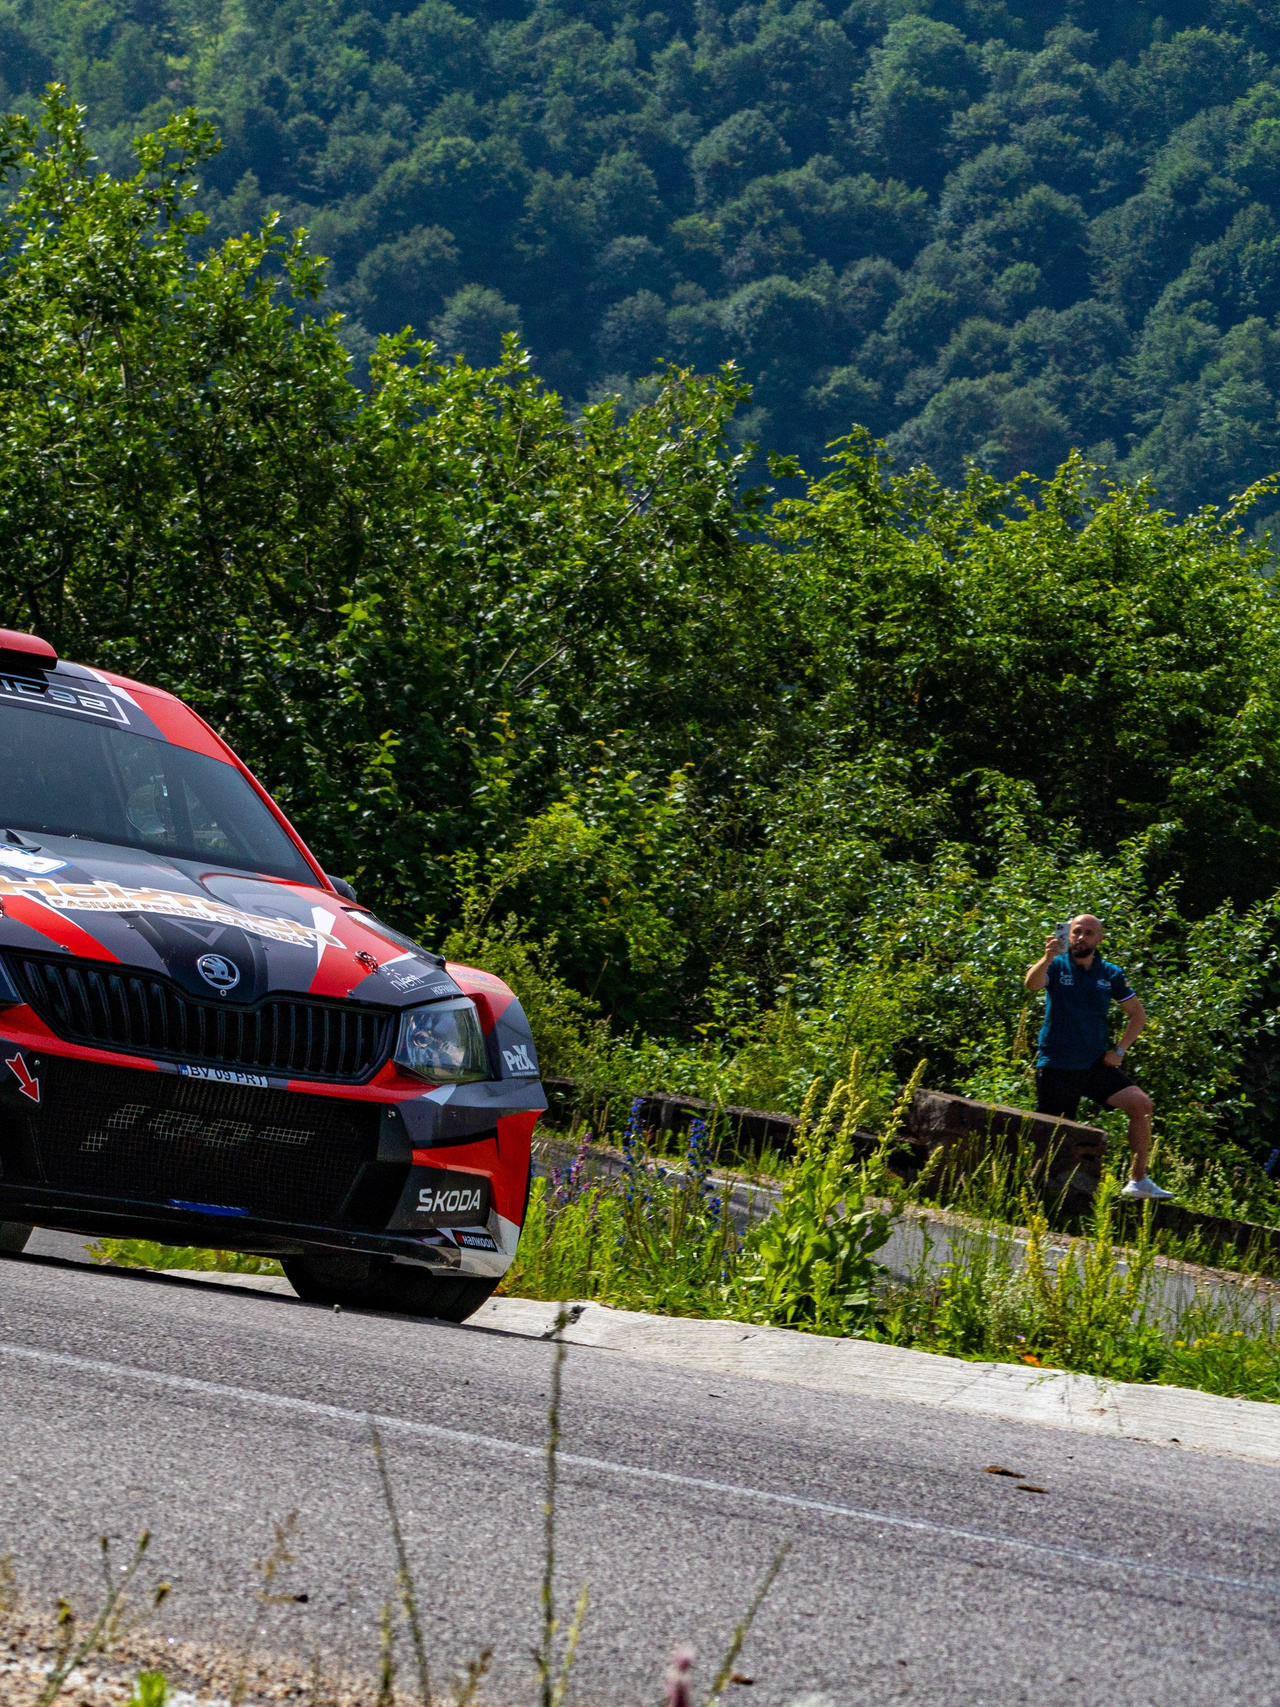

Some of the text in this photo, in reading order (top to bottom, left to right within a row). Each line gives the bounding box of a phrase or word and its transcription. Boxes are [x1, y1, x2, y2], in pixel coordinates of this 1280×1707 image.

[52, 899, 138, 909] PASIUNE
[140, 902, 211, 919] PENTRU
[191, 1066, 210, 1078] BV
[214, 1069, 231, 1081] 09
